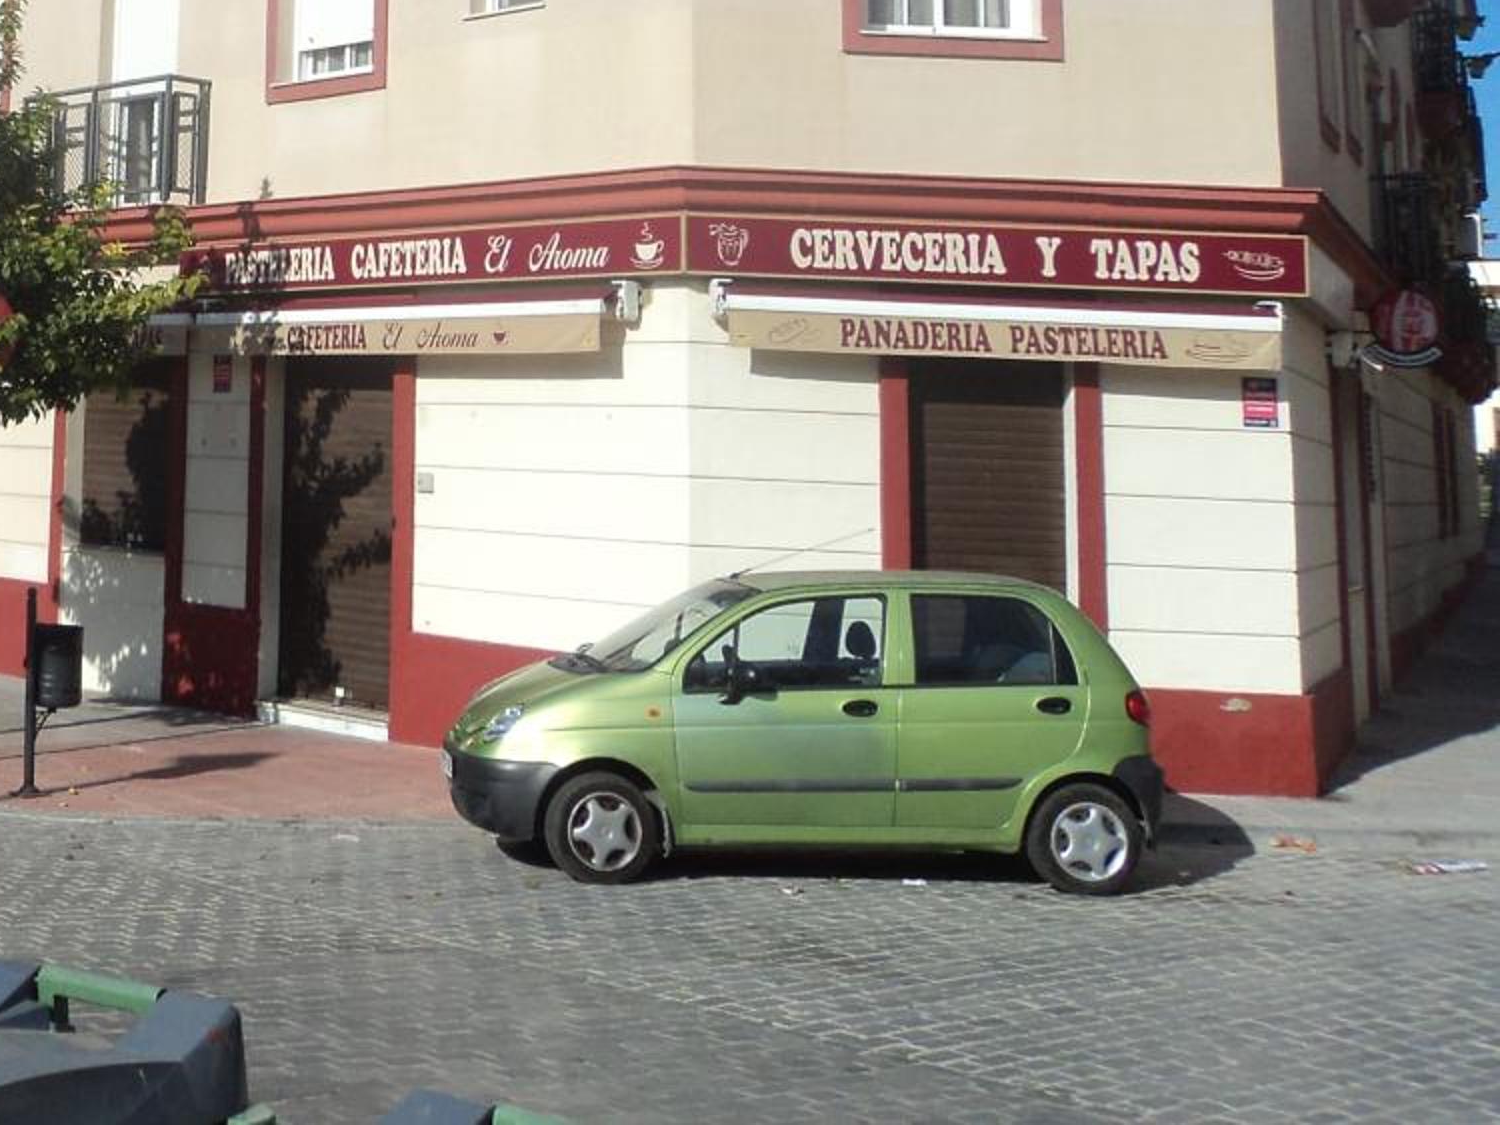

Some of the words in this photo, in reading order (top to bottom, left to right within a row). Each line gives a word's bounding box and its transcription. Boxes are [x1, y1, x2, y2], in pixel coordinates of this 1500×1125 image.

[225, 246, 335, 284] PASTELERIA
[351, 236, 468, 279] CAFETERIA
[484, 234, 512, 274] El
[529, 232, 609, 272] Aroma
[790, 229, 1006, 275] CERVECERIA
[1036, 236, 1062, 278] Y
[1090, 238, 1201, 283] TAPAS
[287, 323, 367, 353] CAFETERIA
[383, 321, 402, 351] El
[417, 322, 479, 350] Aroma
[840, 318, 992, 354] PANADERIA
[1010, 324, 1169, 360] PASTELERIA
